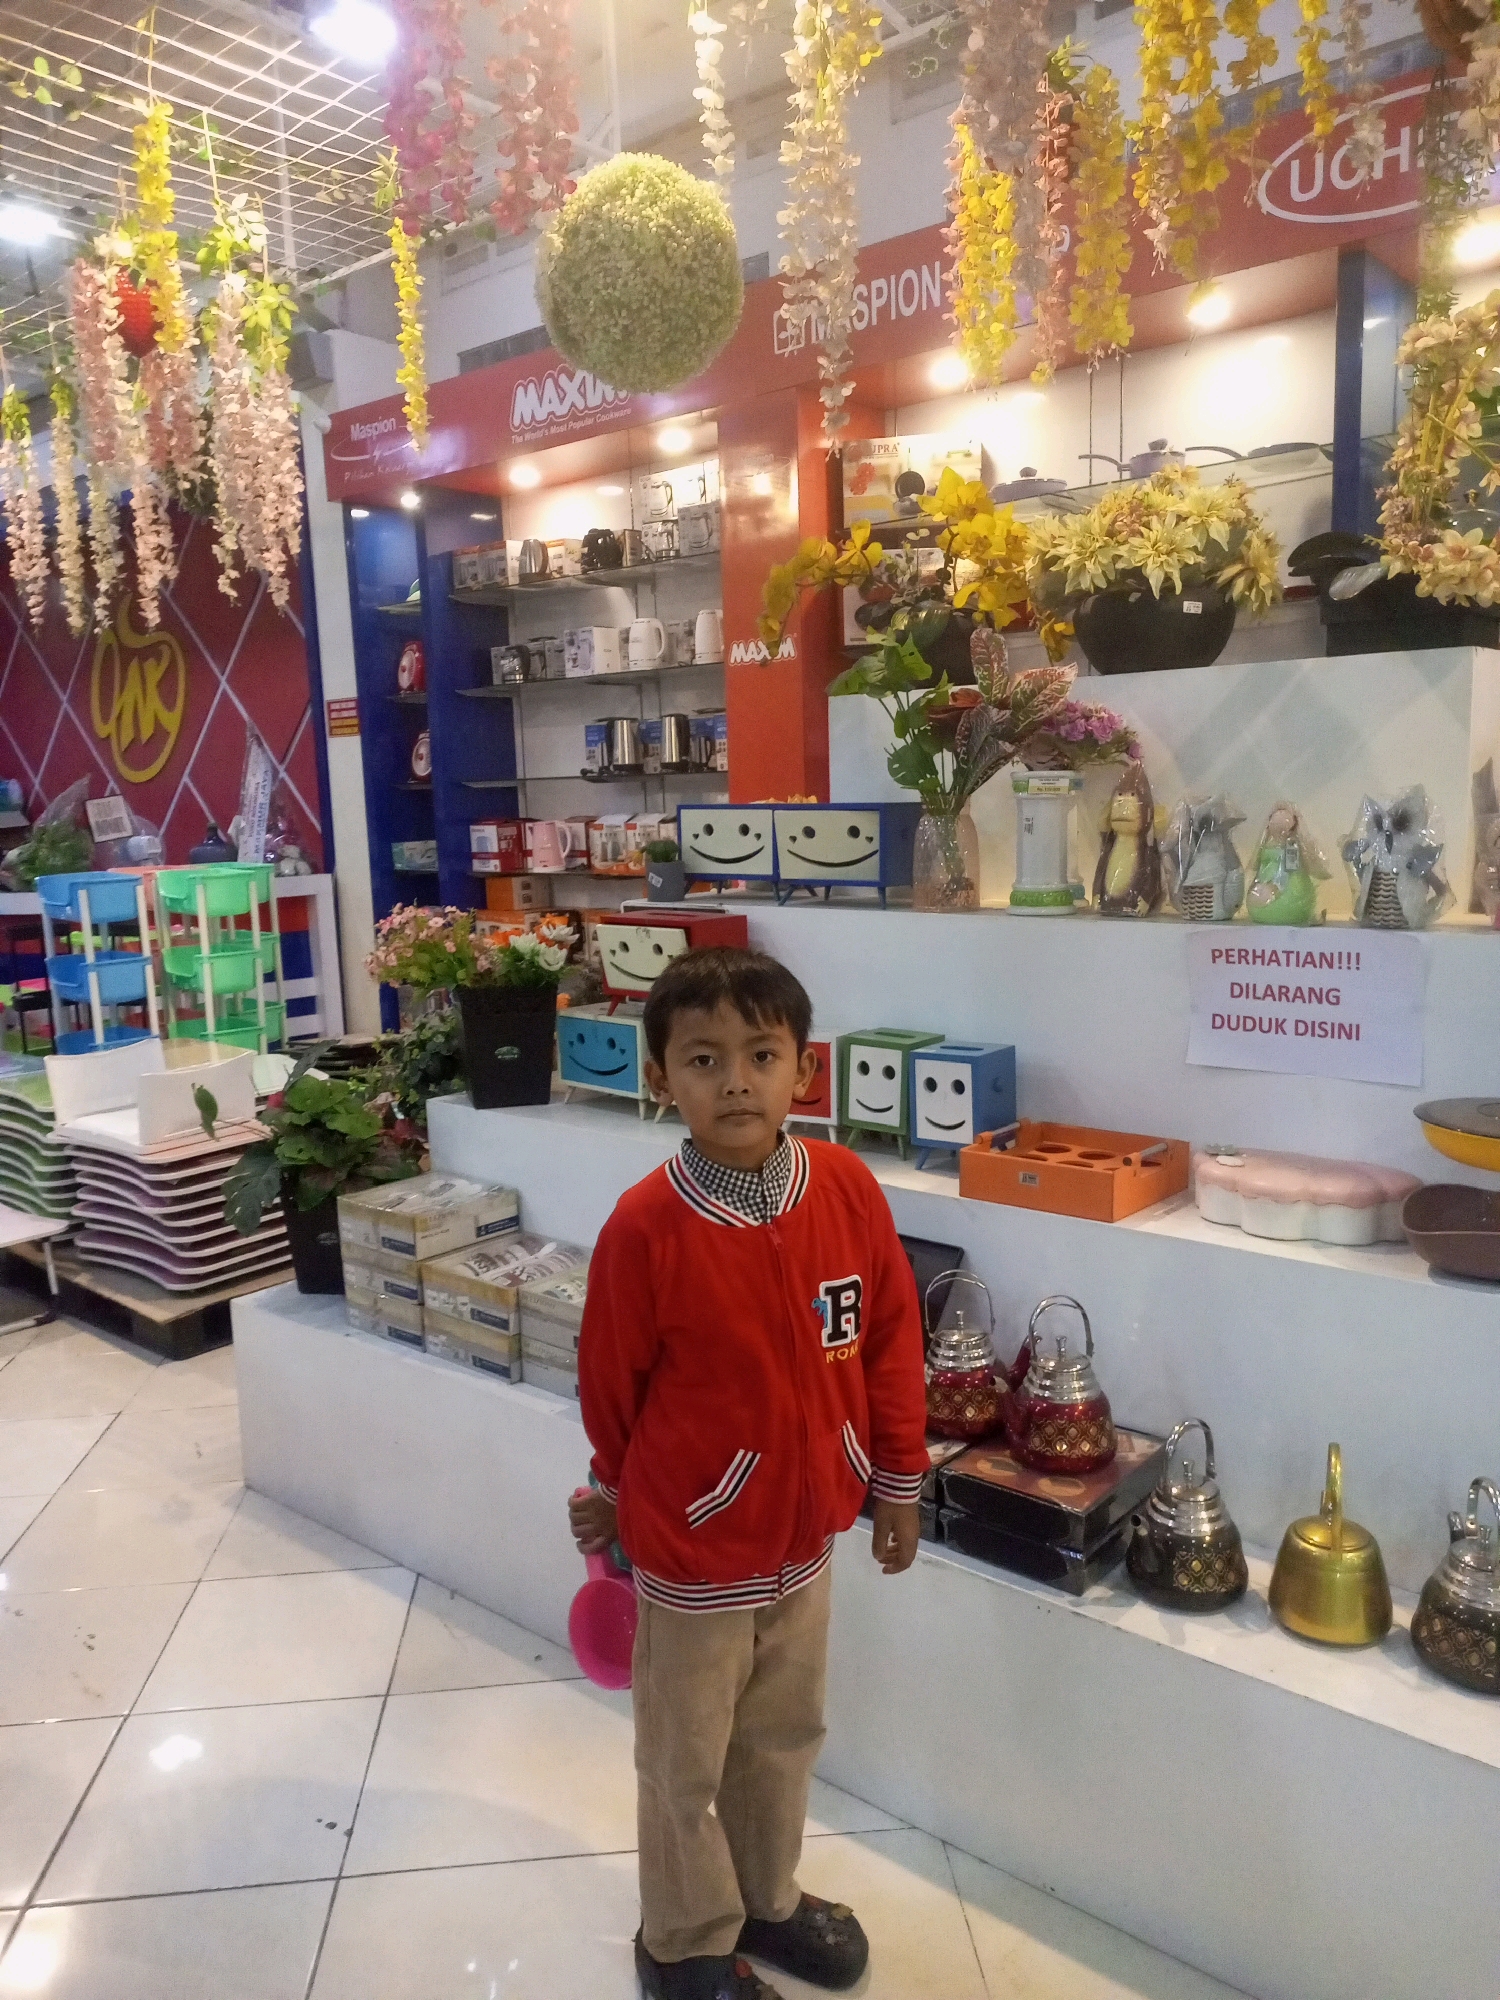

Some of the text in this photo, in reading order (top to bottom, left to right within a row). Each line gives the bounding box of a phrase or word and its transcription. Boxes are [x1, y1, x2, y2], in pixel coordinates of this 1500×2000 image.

[350, 417, 397, 441] Maspion
[525, 428, 548, 440] World's
[550, 424, 567, 434] Most
[568, 418, 594, 430] Popular
[596, 408, 632, 422] Cookware
[730, 635, 797, 664] MAXM
[1211, 948, 1361, 971] PERHATIAN!!!
[1230, 982, 1341, 1006] DILARANG
[1211, 1013, 1361, 1041] DUDUK DISINI
[819, 1274, 863, 1348] R
